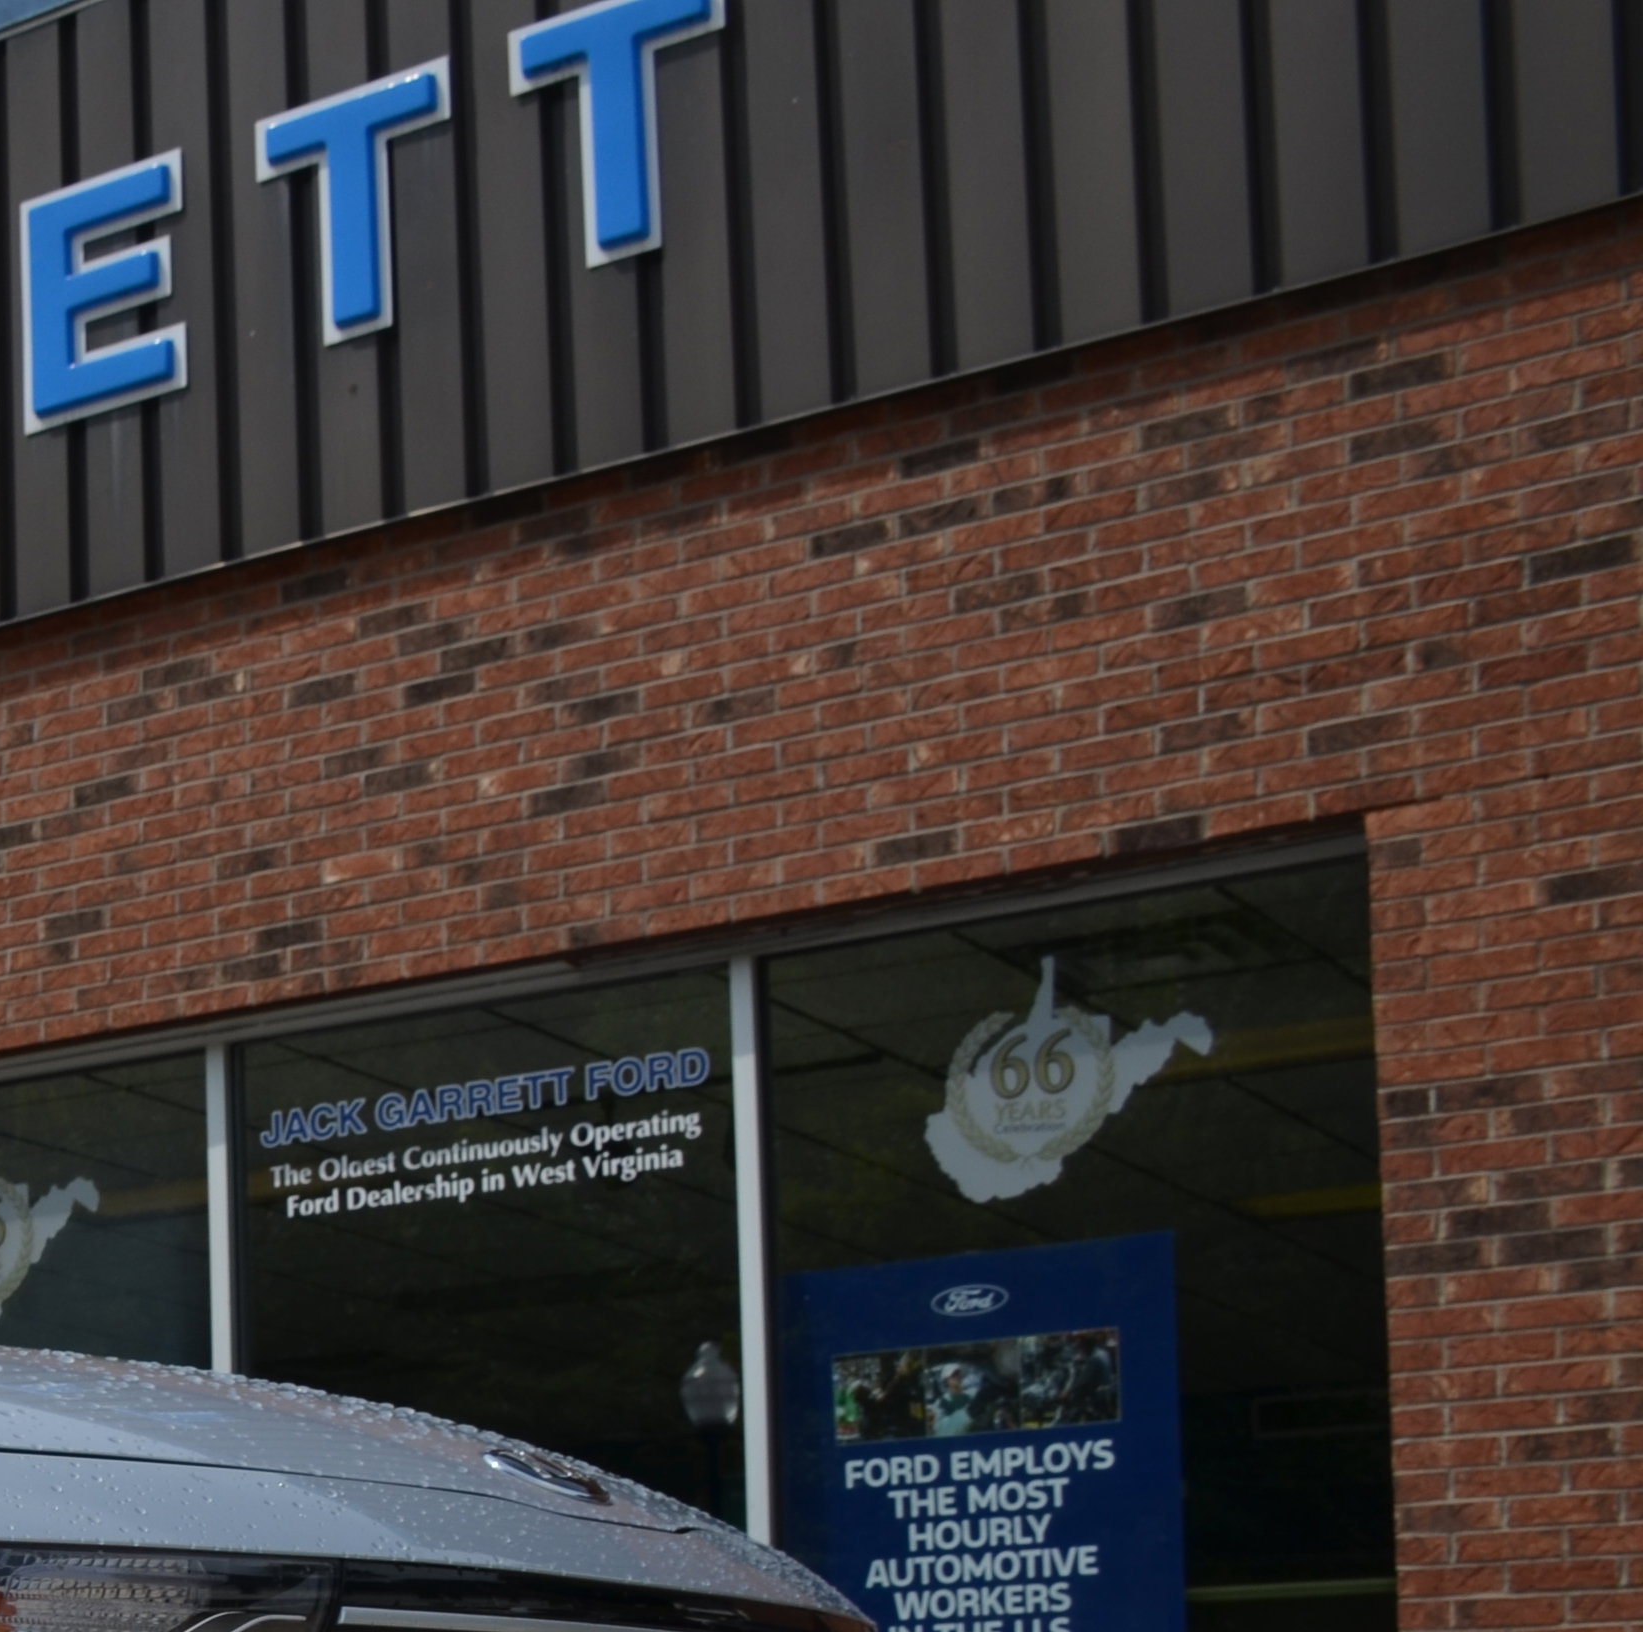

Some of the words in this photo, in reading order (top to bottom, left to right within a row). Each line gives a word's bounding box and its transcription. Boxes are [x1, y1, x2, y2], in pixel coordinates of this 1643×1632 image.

[991, 1029, 1076, 1099] 66
[260, 1097, 367, 1149] JACK
[374, 1066, 576, 1131] GARRETT
[584, 1046, 712, 1102] FORD
[994, 1100, 1066, 1122] YEARS
[270, 1164, 313, 1189] The
[402, 1126, 564, 1172] Continuously
[570, 1109, 703, 1151] Operating
[286, 1186, 340, 1219] Ford
[345, 1170, 475, 1211] Dealership
[481, 1167, 505, 1194] in
[511, 1159, 578, 1189] West
[582, 1143, 684, 1182] Virginia
[844, 1453, 941, 1489] FORD
[949, 1439, 1115, 1481] EMPLOYS
[887, 1486, 957, 1520] THE
[967, 1477, 1070, 1515] MOST
[908, 1513, 1052, 1552] HOURLY
[865, 1545, 1100, 1589] AUTOMOTIVE
[892, 1582, 1073, 1621] WORKERS
